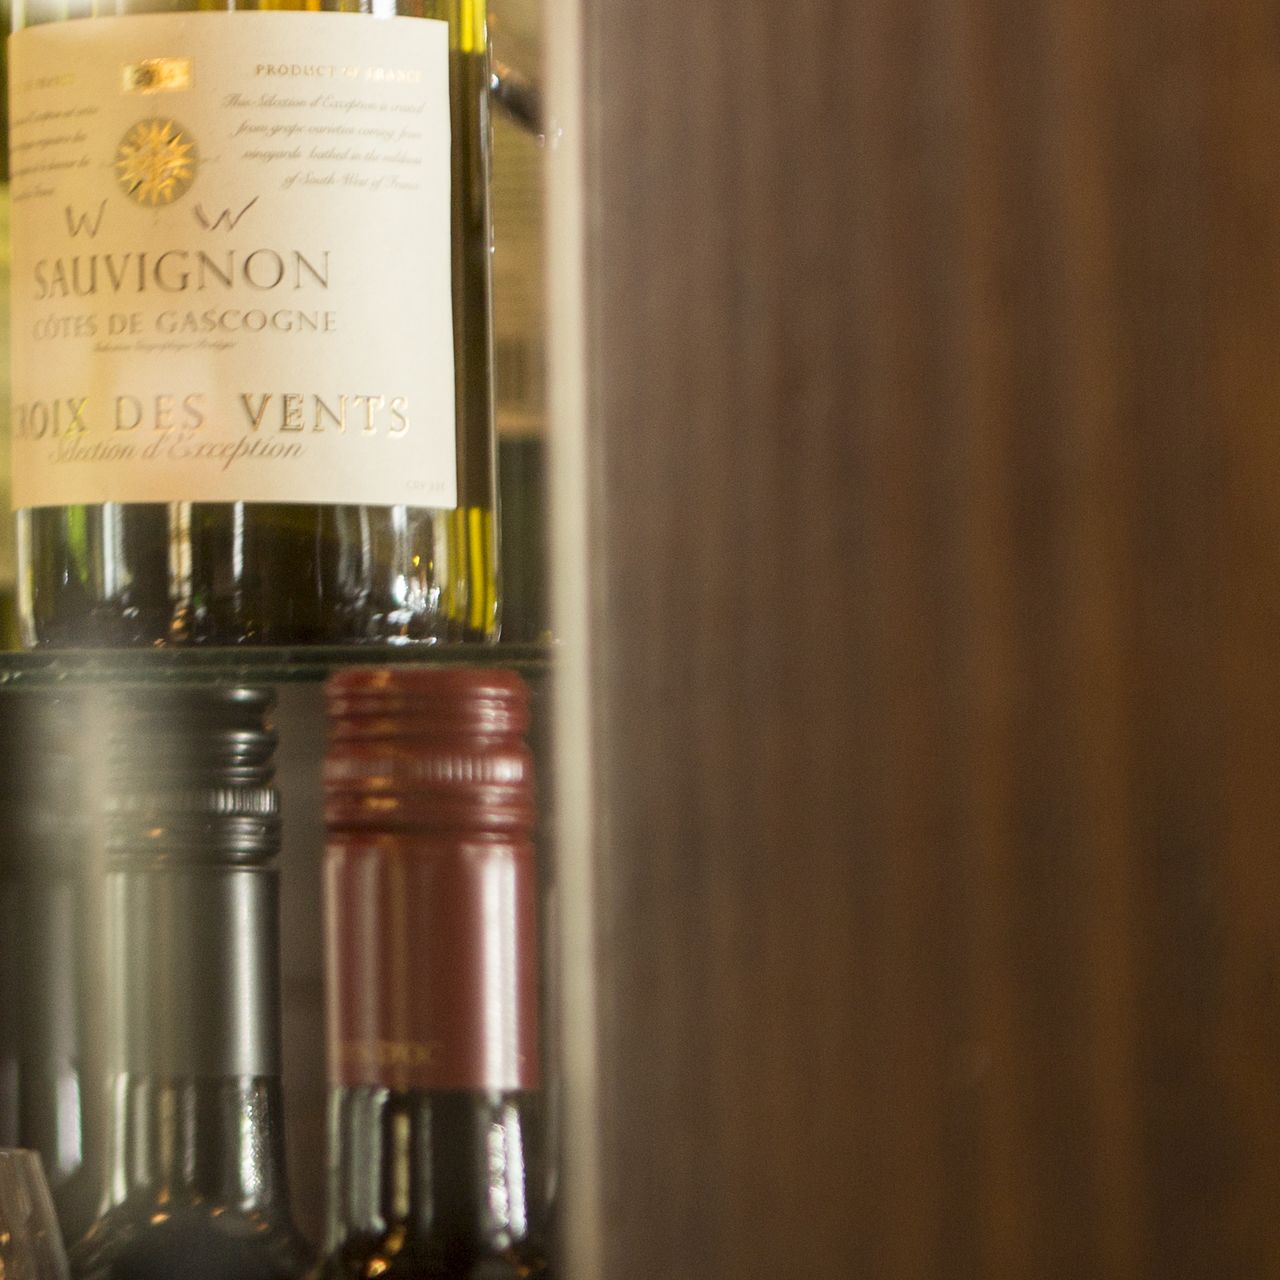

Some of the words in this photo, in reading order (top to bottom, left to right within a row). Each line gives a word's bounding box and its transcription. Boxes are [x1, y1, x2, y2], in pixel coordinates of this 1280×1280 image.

[254, 63, 336, 77] PRODUCT
[33, 248, 332, 301] SAUVIGNON
[106, 311, 144, 336] DE
[154, 307, 338, 335] GASCOGNE
[112, 392, 207, 432] DES
[239, 392, 411, 438] VENTS
